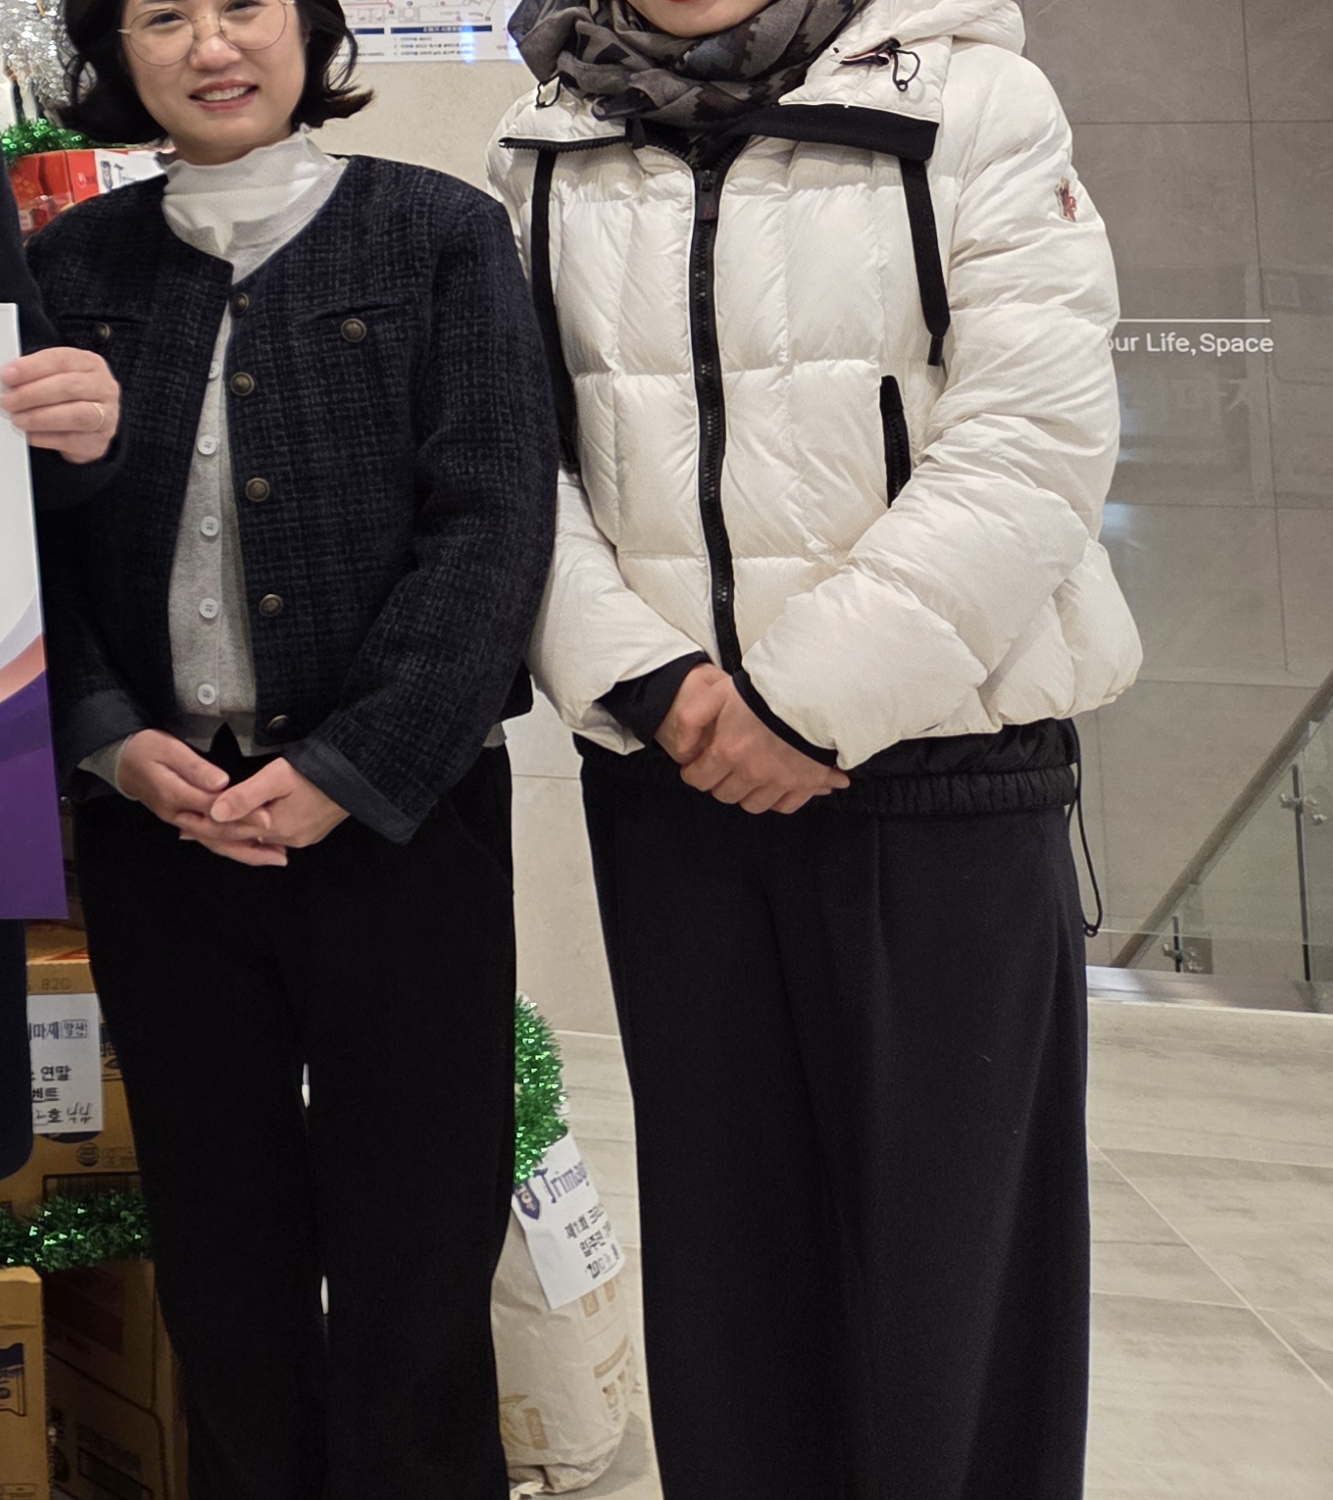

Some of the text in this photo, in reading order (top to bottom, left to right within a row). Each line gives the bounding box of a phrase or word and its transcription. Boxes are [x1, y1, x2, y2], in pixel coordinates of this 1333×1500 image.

[1106, 332, 1275, 357] our Life, Space
[40, 1065, 72, 1082] 연말
[47, 1107, 63, 1124] 호
